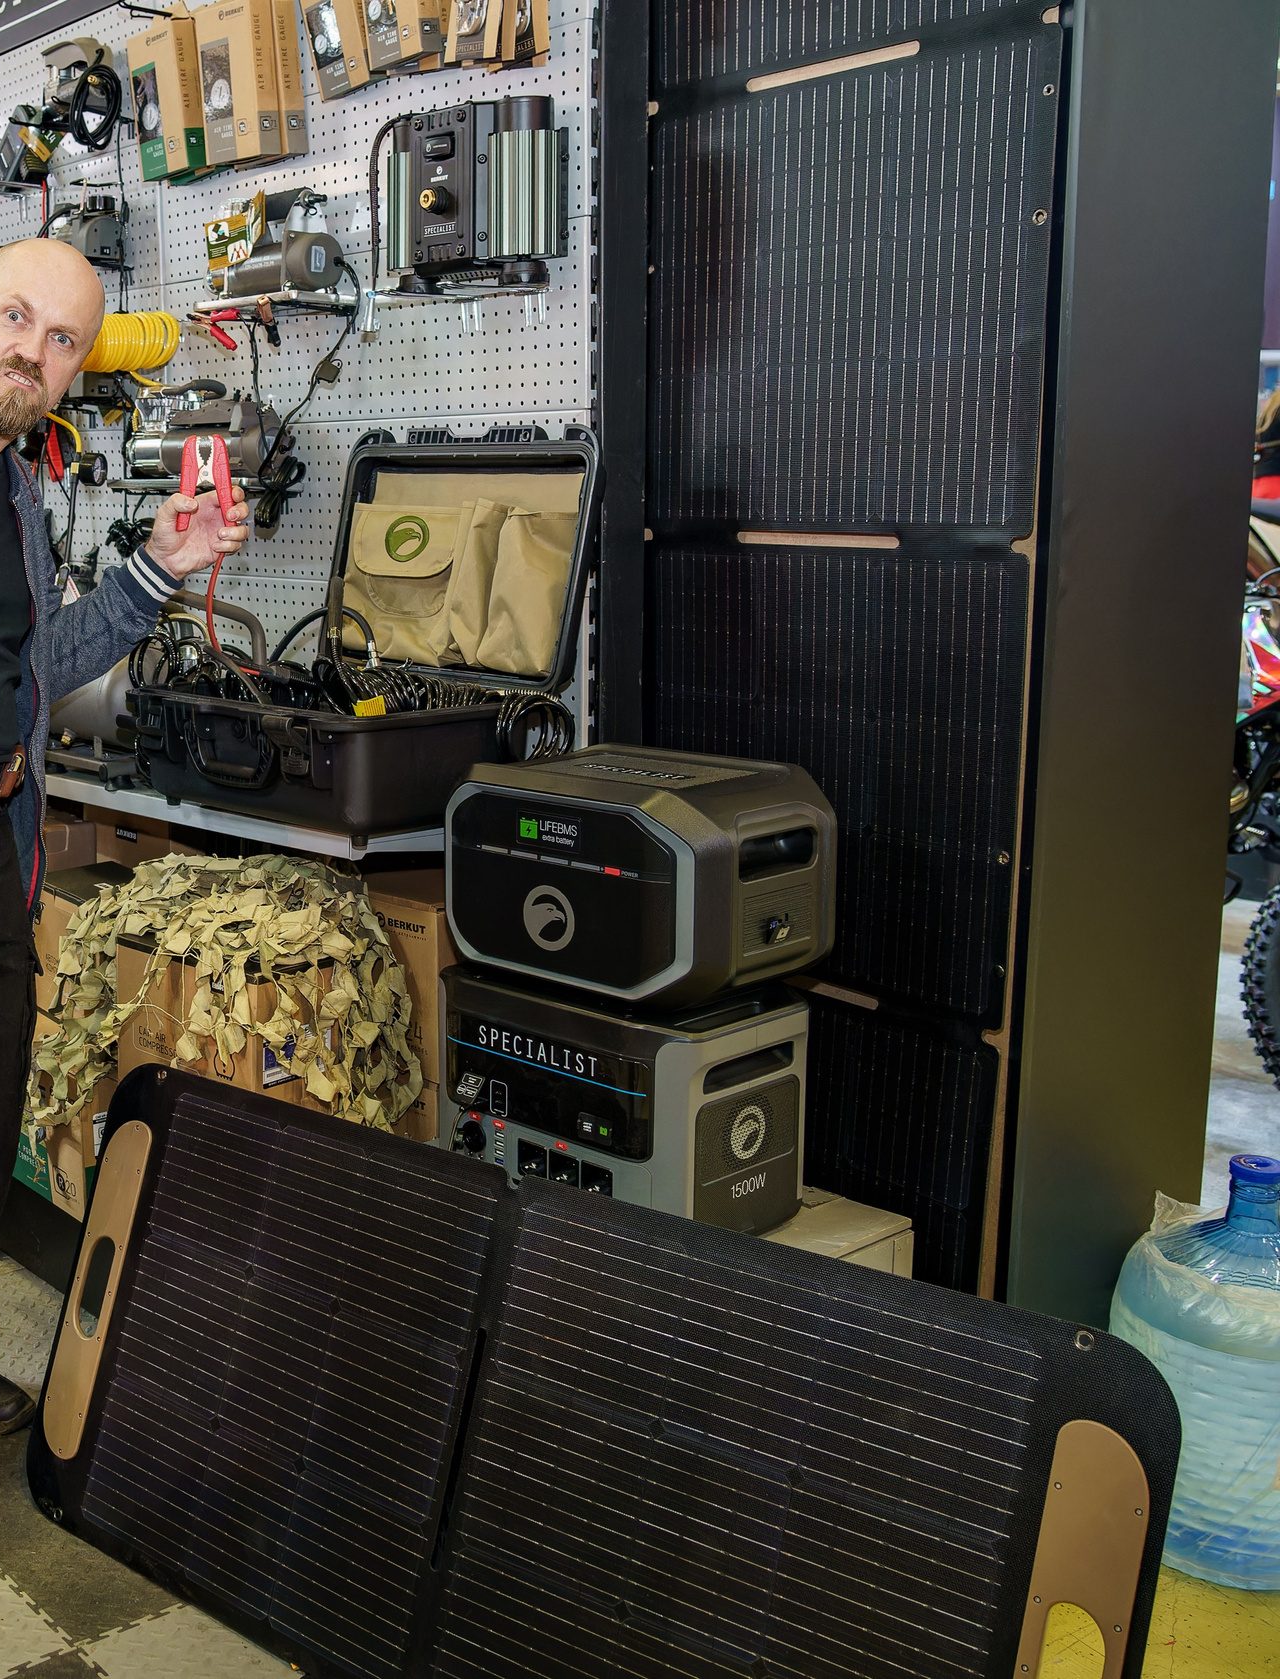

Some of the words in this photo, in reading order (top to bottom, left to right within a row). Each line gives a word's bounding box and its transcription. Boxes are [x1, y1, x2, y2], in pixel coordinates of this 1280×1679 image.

[278, 14, 286, 41] GAUGE
[176, 36, 185, 62] GAUGE
[281, 47, 289, 70] TIRE
[180, 67, 188, 88] TIRE
[182, 92, 190, 108] AIR
[424, 224, 455, 235] SPECIALIST
[539, 820, 578, 837] LIFEBMS
[542, 834, 556, 843] extra
[556, 835, 575, 848] battery
[621, 870, 639, 878] POWER
[388, 917, 426, 935] BERKUT
[155, 1032, 167, 1042] AIR
[479, 1025, 598, 1078] SPECIALIST
[731, 1172, 767, 1199] 1500W
